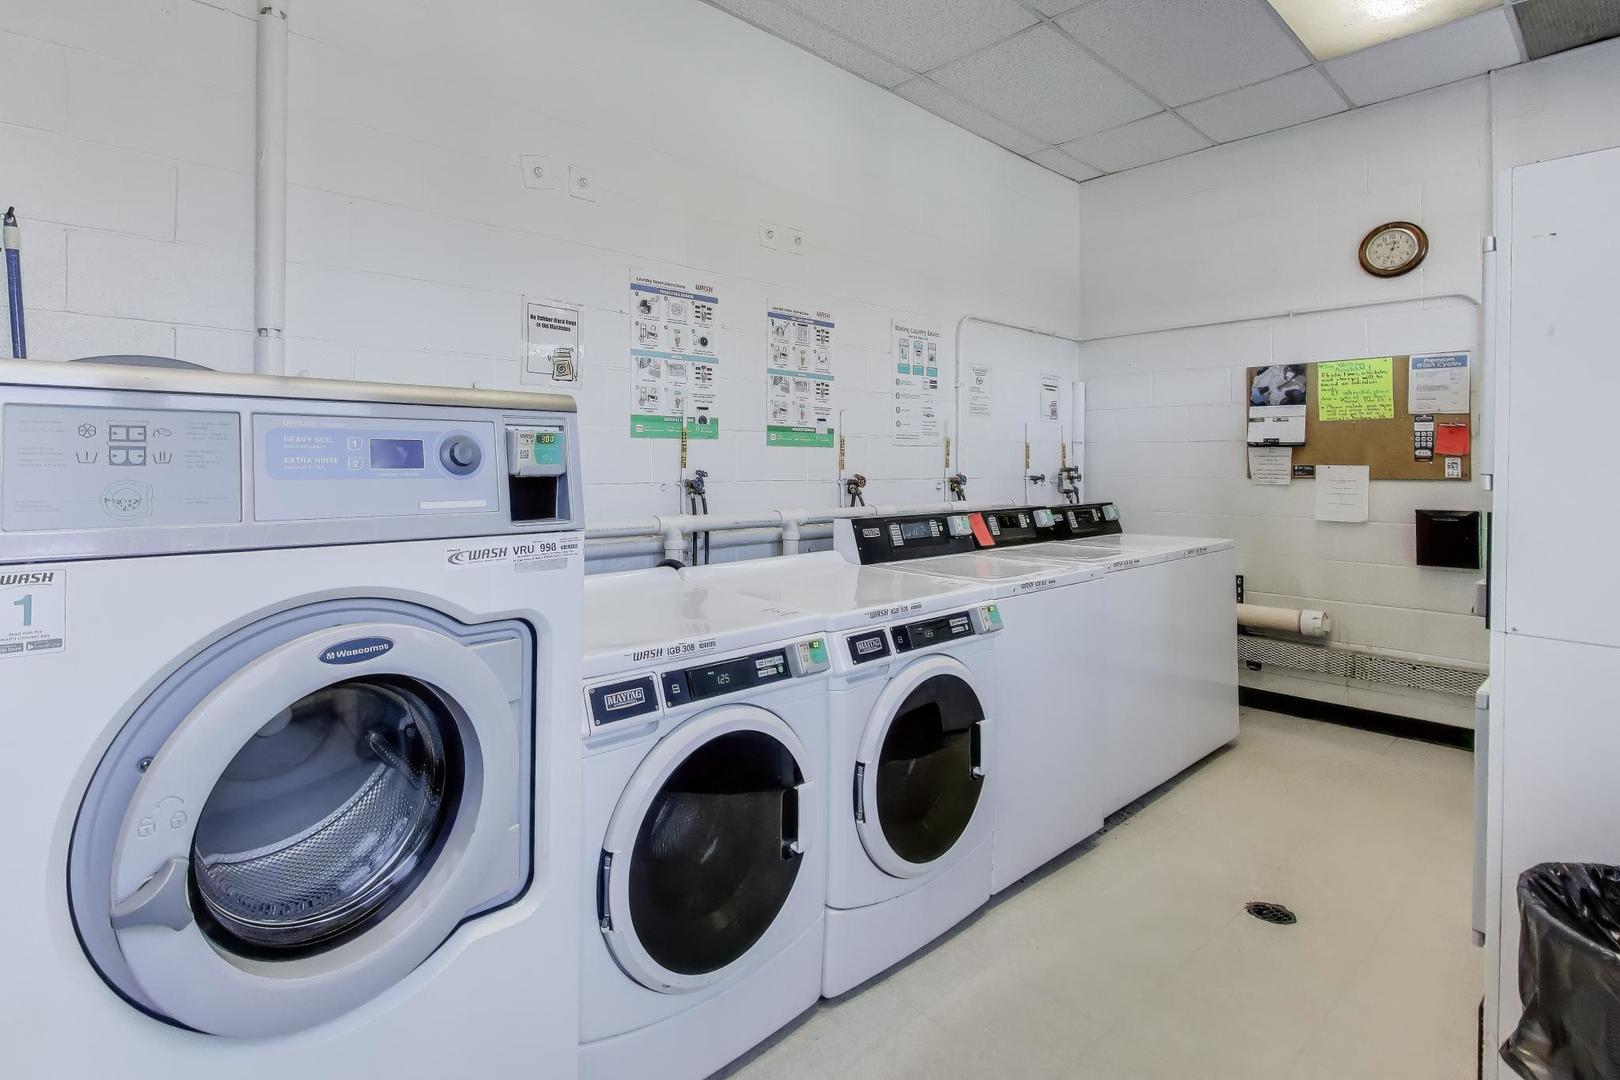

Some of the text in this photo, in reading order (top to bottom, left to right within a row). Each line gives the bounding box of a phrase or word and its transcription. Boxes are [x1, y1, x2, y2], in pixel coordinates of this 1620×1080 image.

[468, 547, 507, 560] WASH
[513, 545, 534, 555] VRU
[0, 572, 54, 585] WASH
[14, 595, 32, 626] 1
[633, 648, 663, 661] WASH
[667, 646, 680, 656] IGB
[682, 644, 695, 653] 308
[607, 688, 642, 706] MAYTAG
